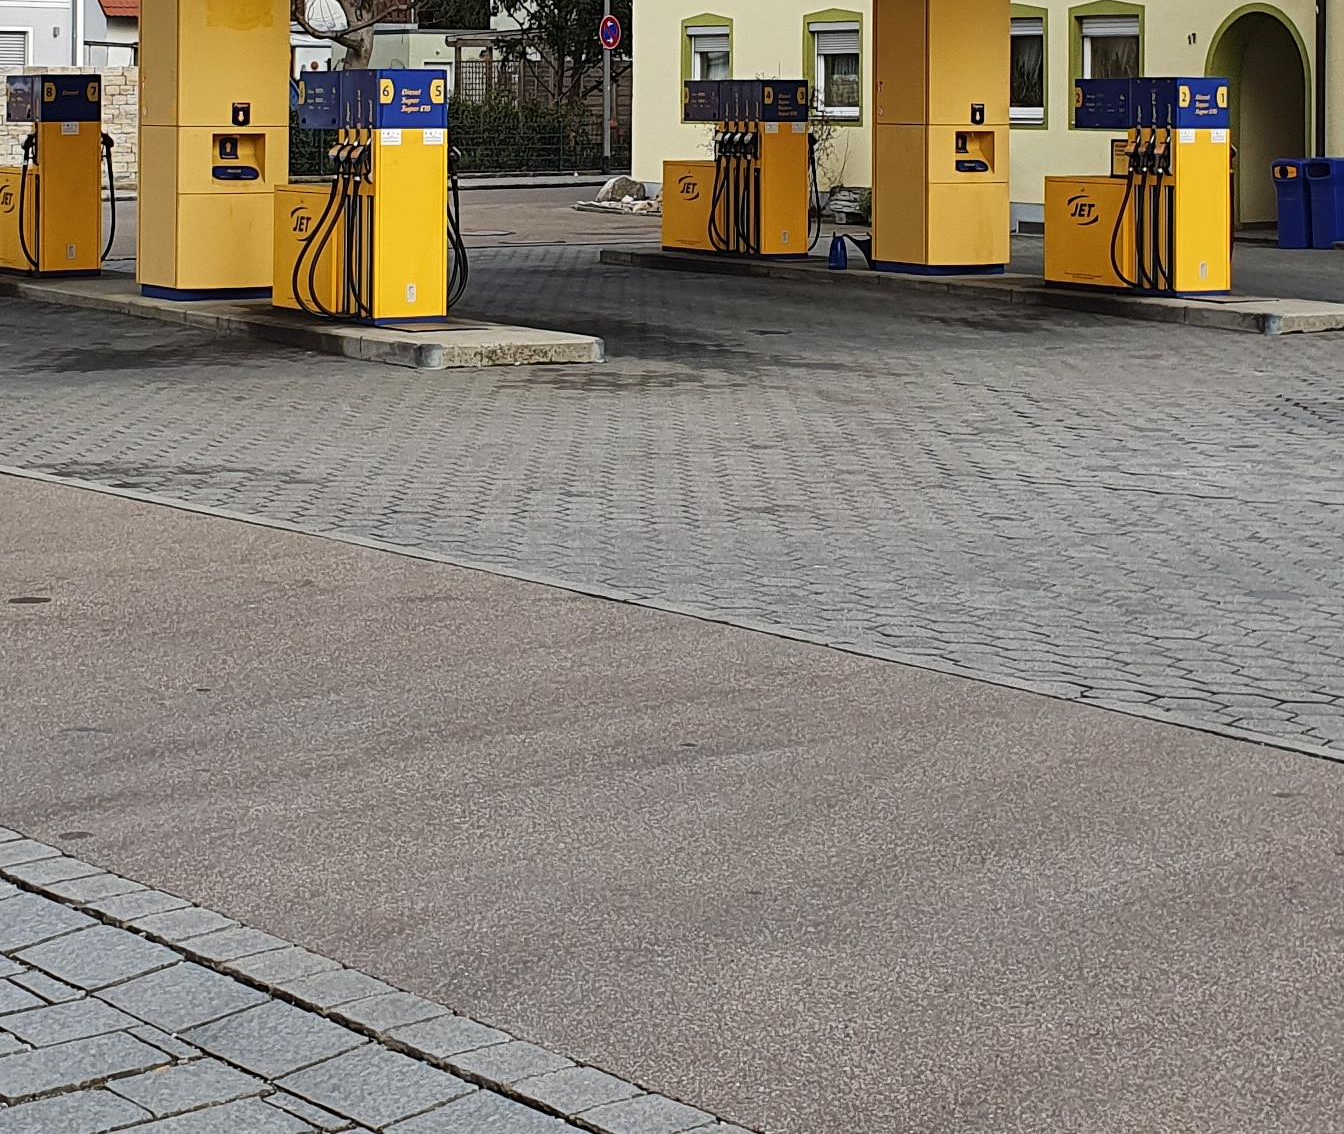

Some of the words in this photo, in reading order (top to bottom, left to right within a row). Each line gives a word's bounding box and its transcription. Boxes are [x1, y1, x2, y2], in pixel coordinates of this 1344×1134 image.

[46, 87, 53, 97] 8
[91, 87, 97, 96] 7
[382, 85, 390, 97] 6
[435, 85, 442, 97] 5
[766, 91, 771, 100] 4
[799, 91, 805, 100] 3
[1181, 91, 1187, 102] 2
[680, 182, 698, 194] JET
[0, 192, 14, 205] JET
[1070, 202, 1096, 218] JET
[292, 216, 312, 232] JET
